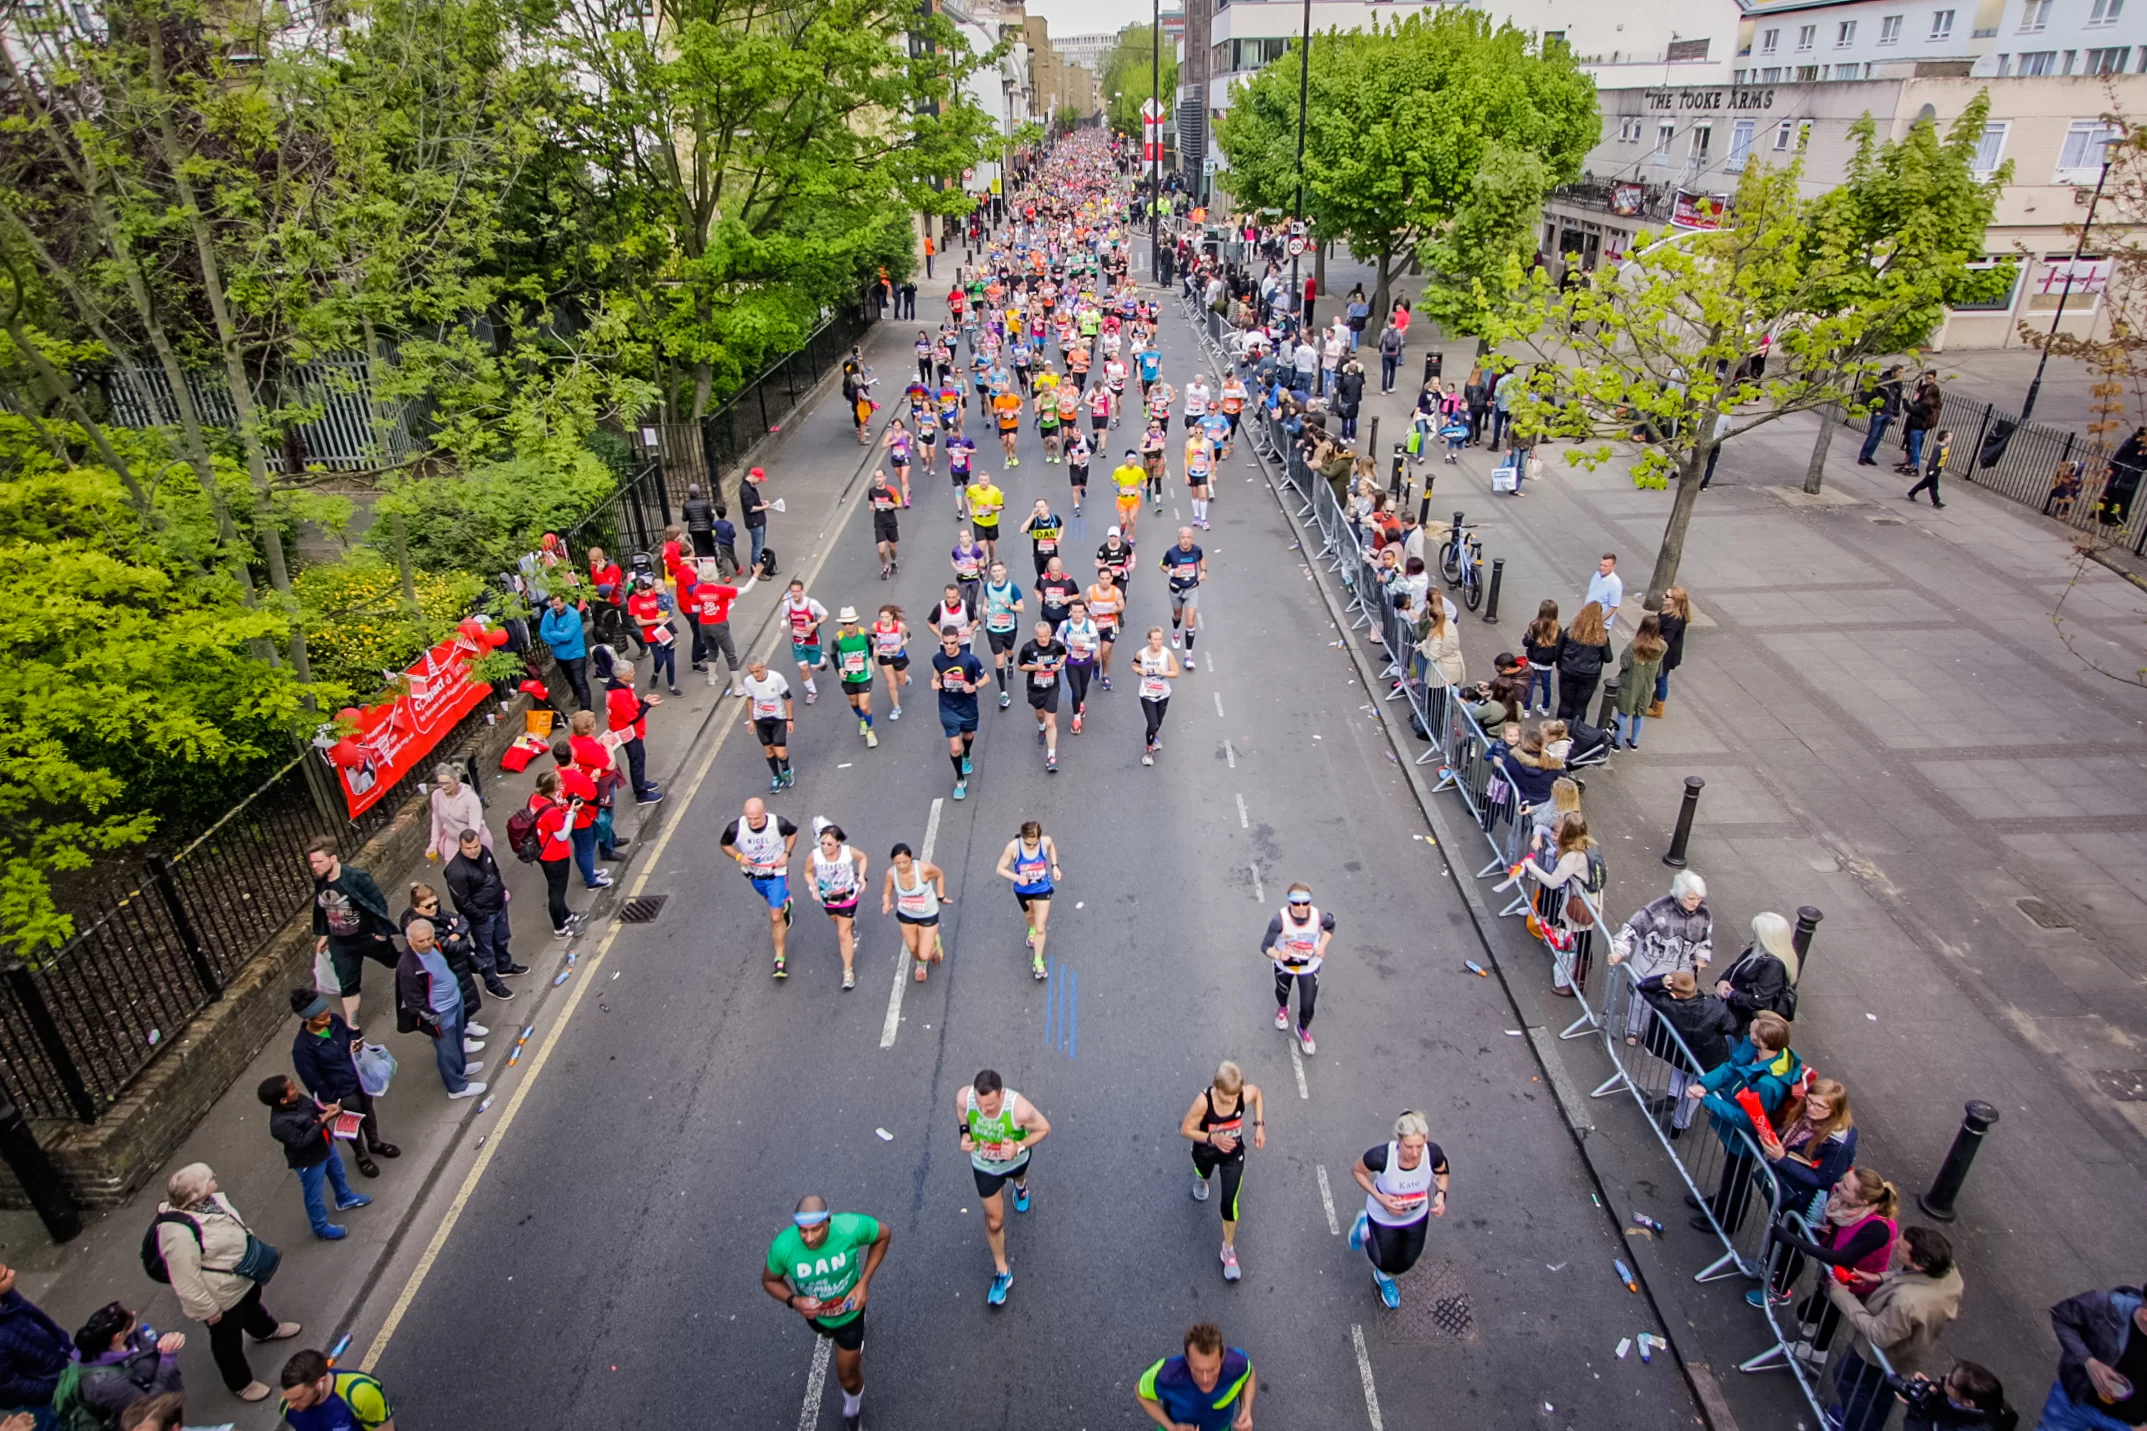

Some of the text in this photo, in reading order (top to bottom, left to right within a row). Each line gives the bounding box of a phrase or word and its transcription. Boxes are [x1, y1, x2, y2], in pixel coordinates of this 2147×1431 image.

[1650, 90, 1774, 109] THE TOOKE ARMS
[1291, 243, 1302, 251] 20
[1399, 1181, 1420, 1190] Kate
[797, 1252, 846, 1278] DAN
